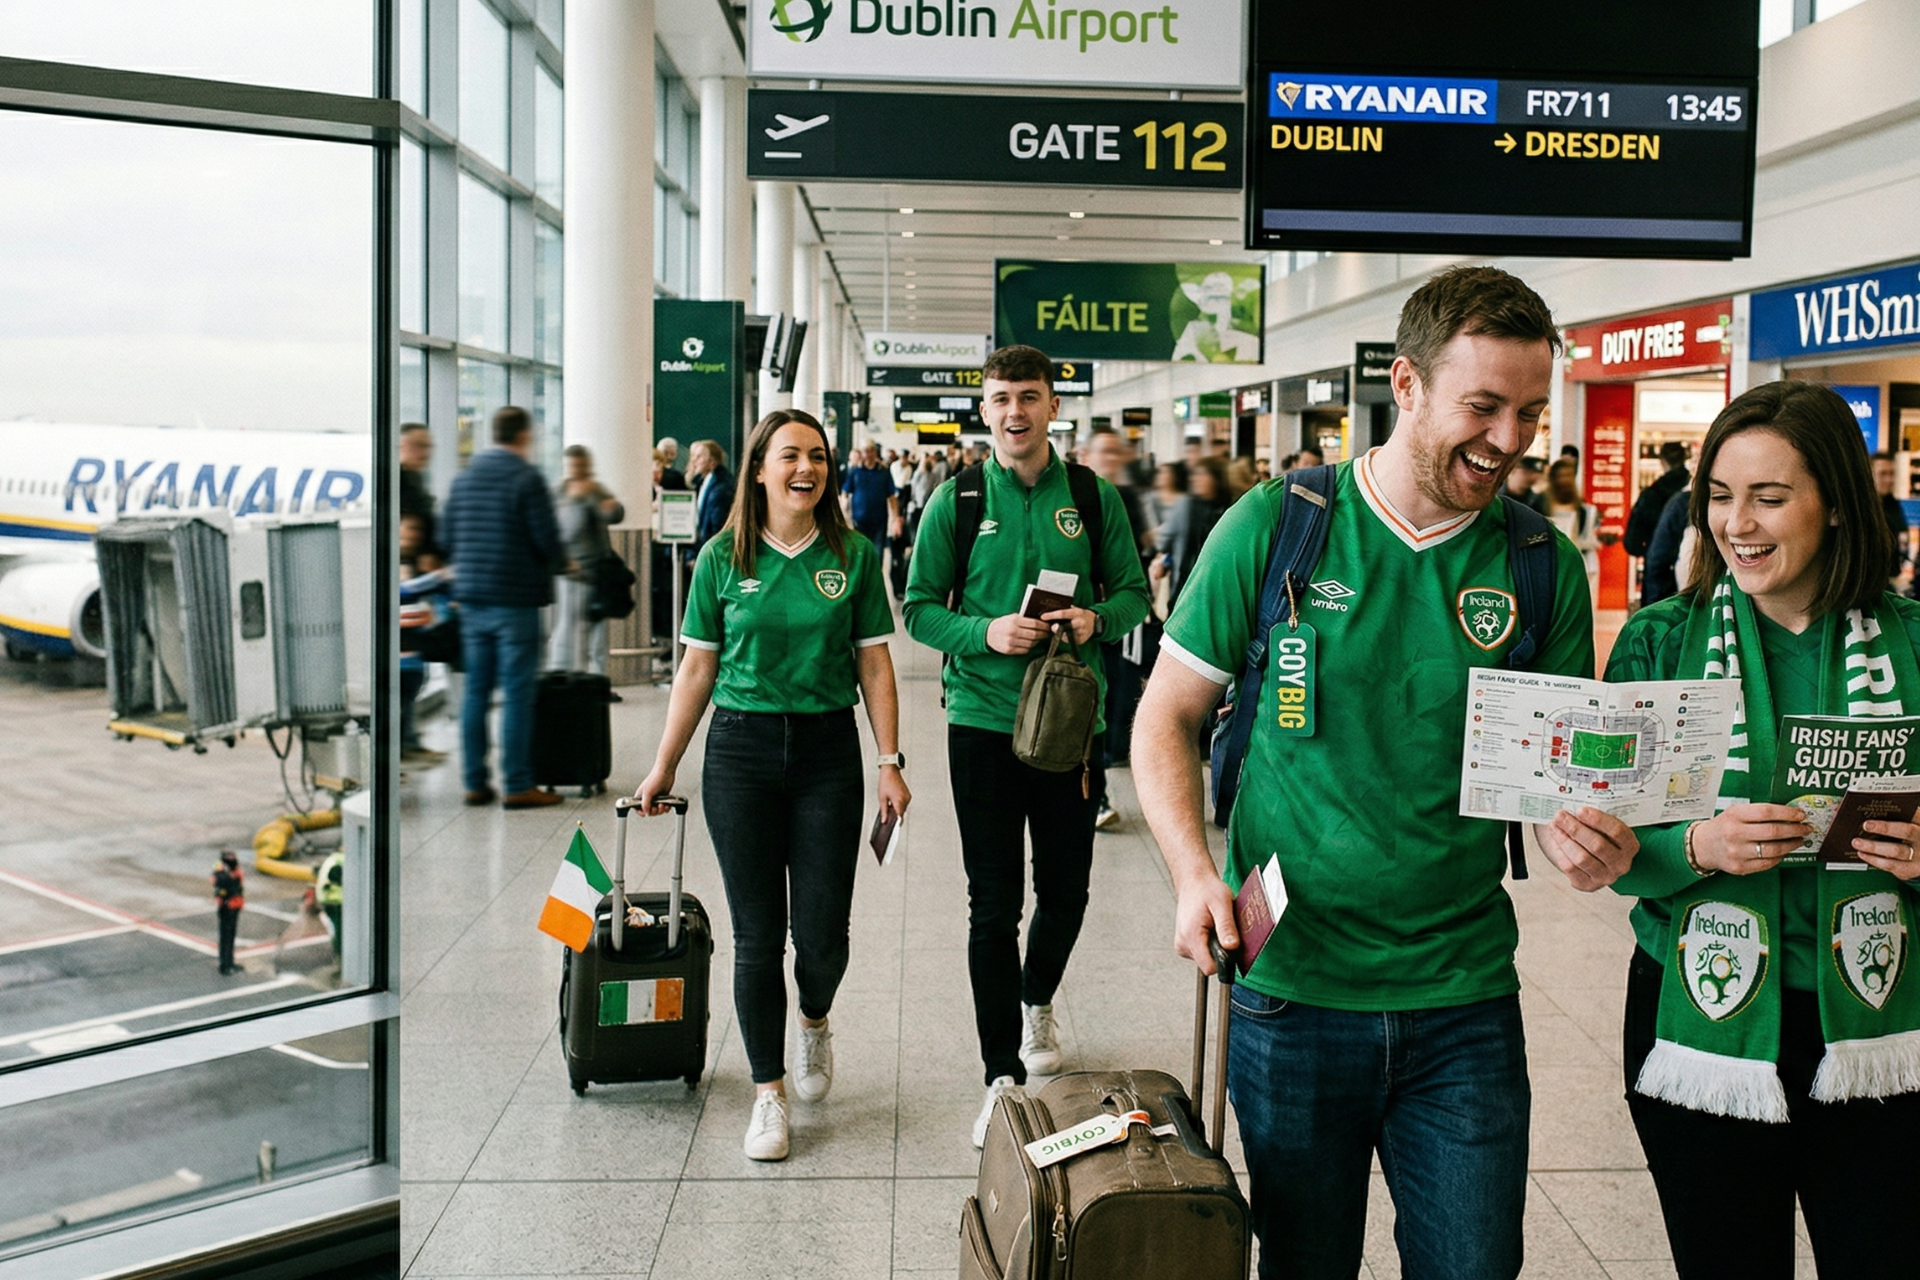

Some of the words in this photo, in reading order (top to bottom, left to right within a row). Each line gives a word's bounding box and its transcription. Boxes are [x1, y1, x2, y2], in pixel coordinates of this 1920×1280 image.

[850, 0, 997, 38] Dublin
[1008, 0, 1179, 53] Airport
[1304, 83, 1488, 115] RYANAIR
[1526, 89, 1610, 119] FR711
[1666, 93, 1742, 122] 13:45
[1009, 122, 1121, 161] GATE
[1133, 120, 1228, 171] 112
[1271, 124, 1383, 152] DUBLIN
[1525, 131, 1660, 160] DRESDEN
[1036, 294, 1149, 333] FÁILTE
[1794, 270, 1920, 348] WHSm
[1601, 327, 1643, 366] DUTY
[1643, 320, 1686, 360] FREE
[922, 371, 953, 384] GATE
[955, 370, 983, 386] 112
[64, 457, 364, 518] RYANAIR
[1311, 598, 1348, 612] umbro
[1469, 594, 1505, 608] Ireland
[1278, 637, 1307, 729] COYBIG
[1790, 726, 1849, 748] IRISH
[1855, 727, 1916, 748] FANS'
[1795, 747, 1870, 769] GUIDE
[1877, 748, 1906, 769] TO
[1695, 910, 1750, 939] Ireland
[1042, 1126, 1106, 1156] COYBIG
